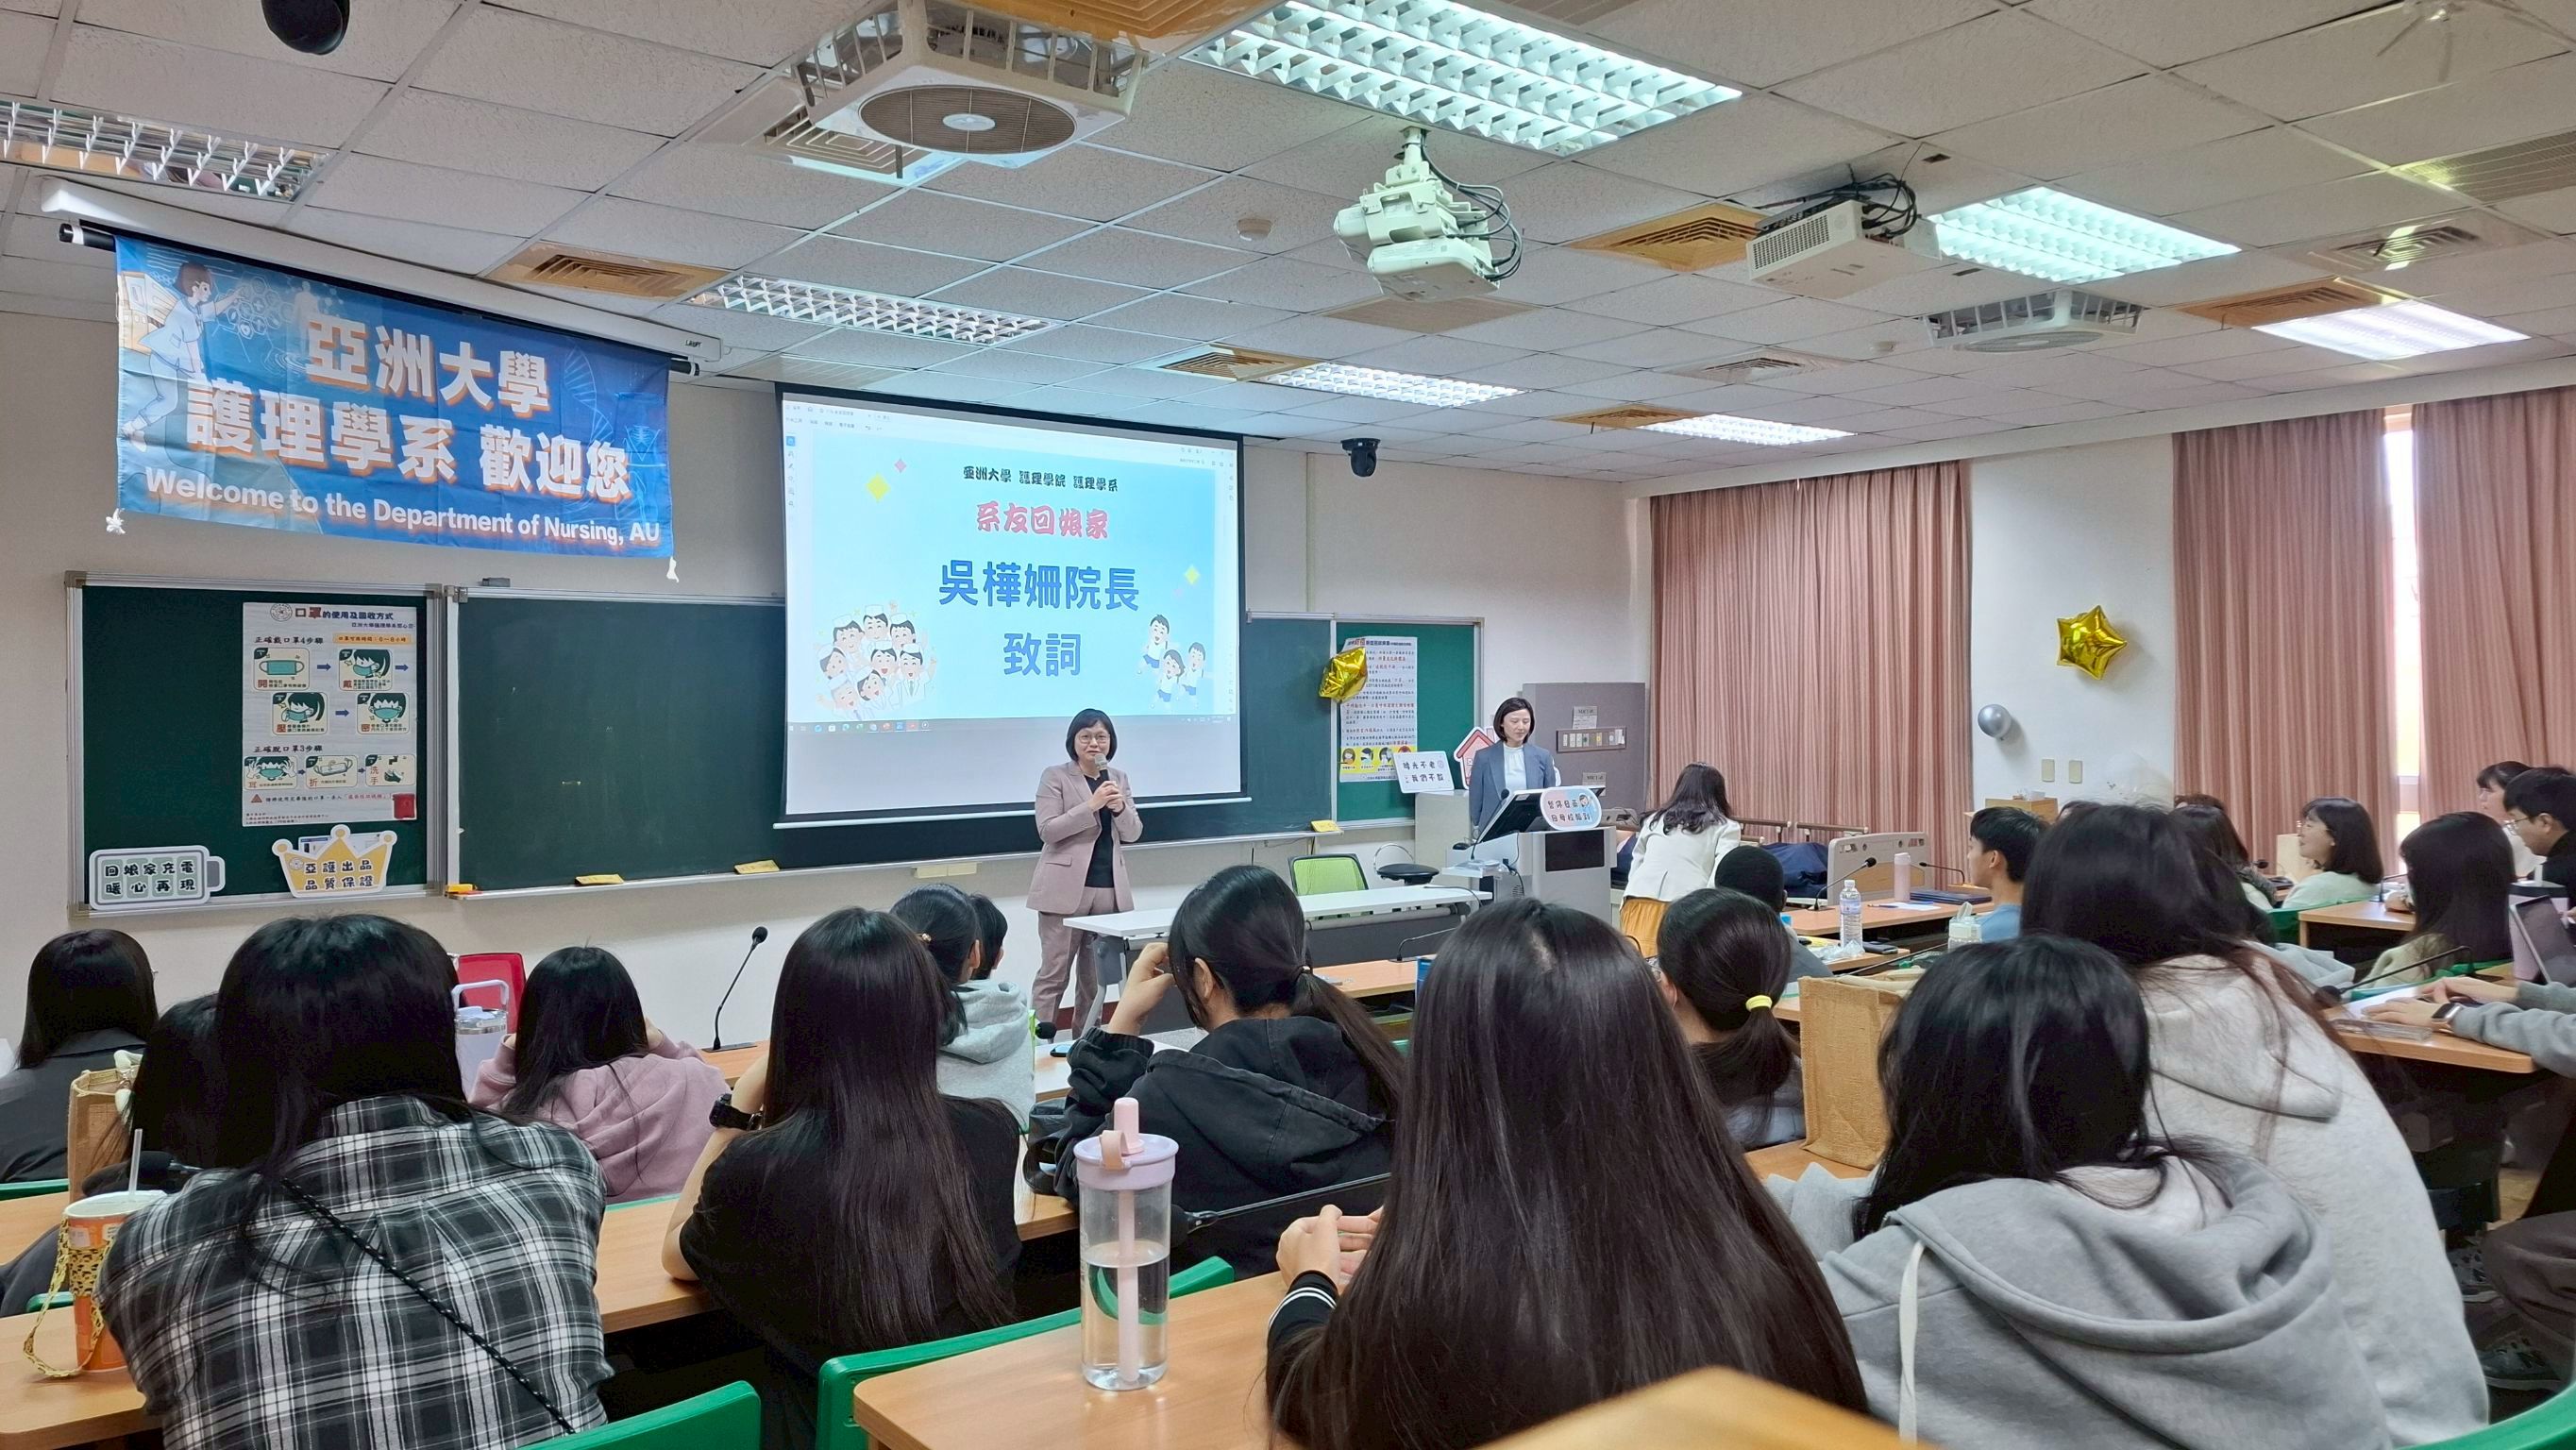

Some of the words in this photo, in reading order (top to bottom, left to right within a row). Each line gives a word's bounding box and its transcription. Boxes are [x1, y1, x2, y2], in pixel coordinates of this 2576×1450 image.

[305, 312, 550, 416] 亞洲大學
[186, 379, 456, 482] 護理學系
[479, 424, 631, 501] 歡迎您
[963, 466, 1012, 483] 亞洲大學
[1019, 470, 1067, 489] 護理學院
[1073, 475, 1120, 493] 護理學系
[144, 466, 283, 510] Welcome
[290, 488, 319, 514] to
[326, 493, 367, 520] the
[373, 499, 514, 537] Department
[517, 514, 540, 537] of
[544, 516, 624, 546] Nursing,
[629, 521, 660, 543] AU
[976, 500, 1109, 540] 系友回娘家
[938, 560, 1140, 612] 吳樺姍院長
[1003, 632, 1082, 677] 致詞
[105, 860, 194, 877] 回娘家充電
[304, 860, 372, 874] 亞護出品
[304, 875, 373, 891] 品質保證
[106, 879, 195, 896] 暖心再現
